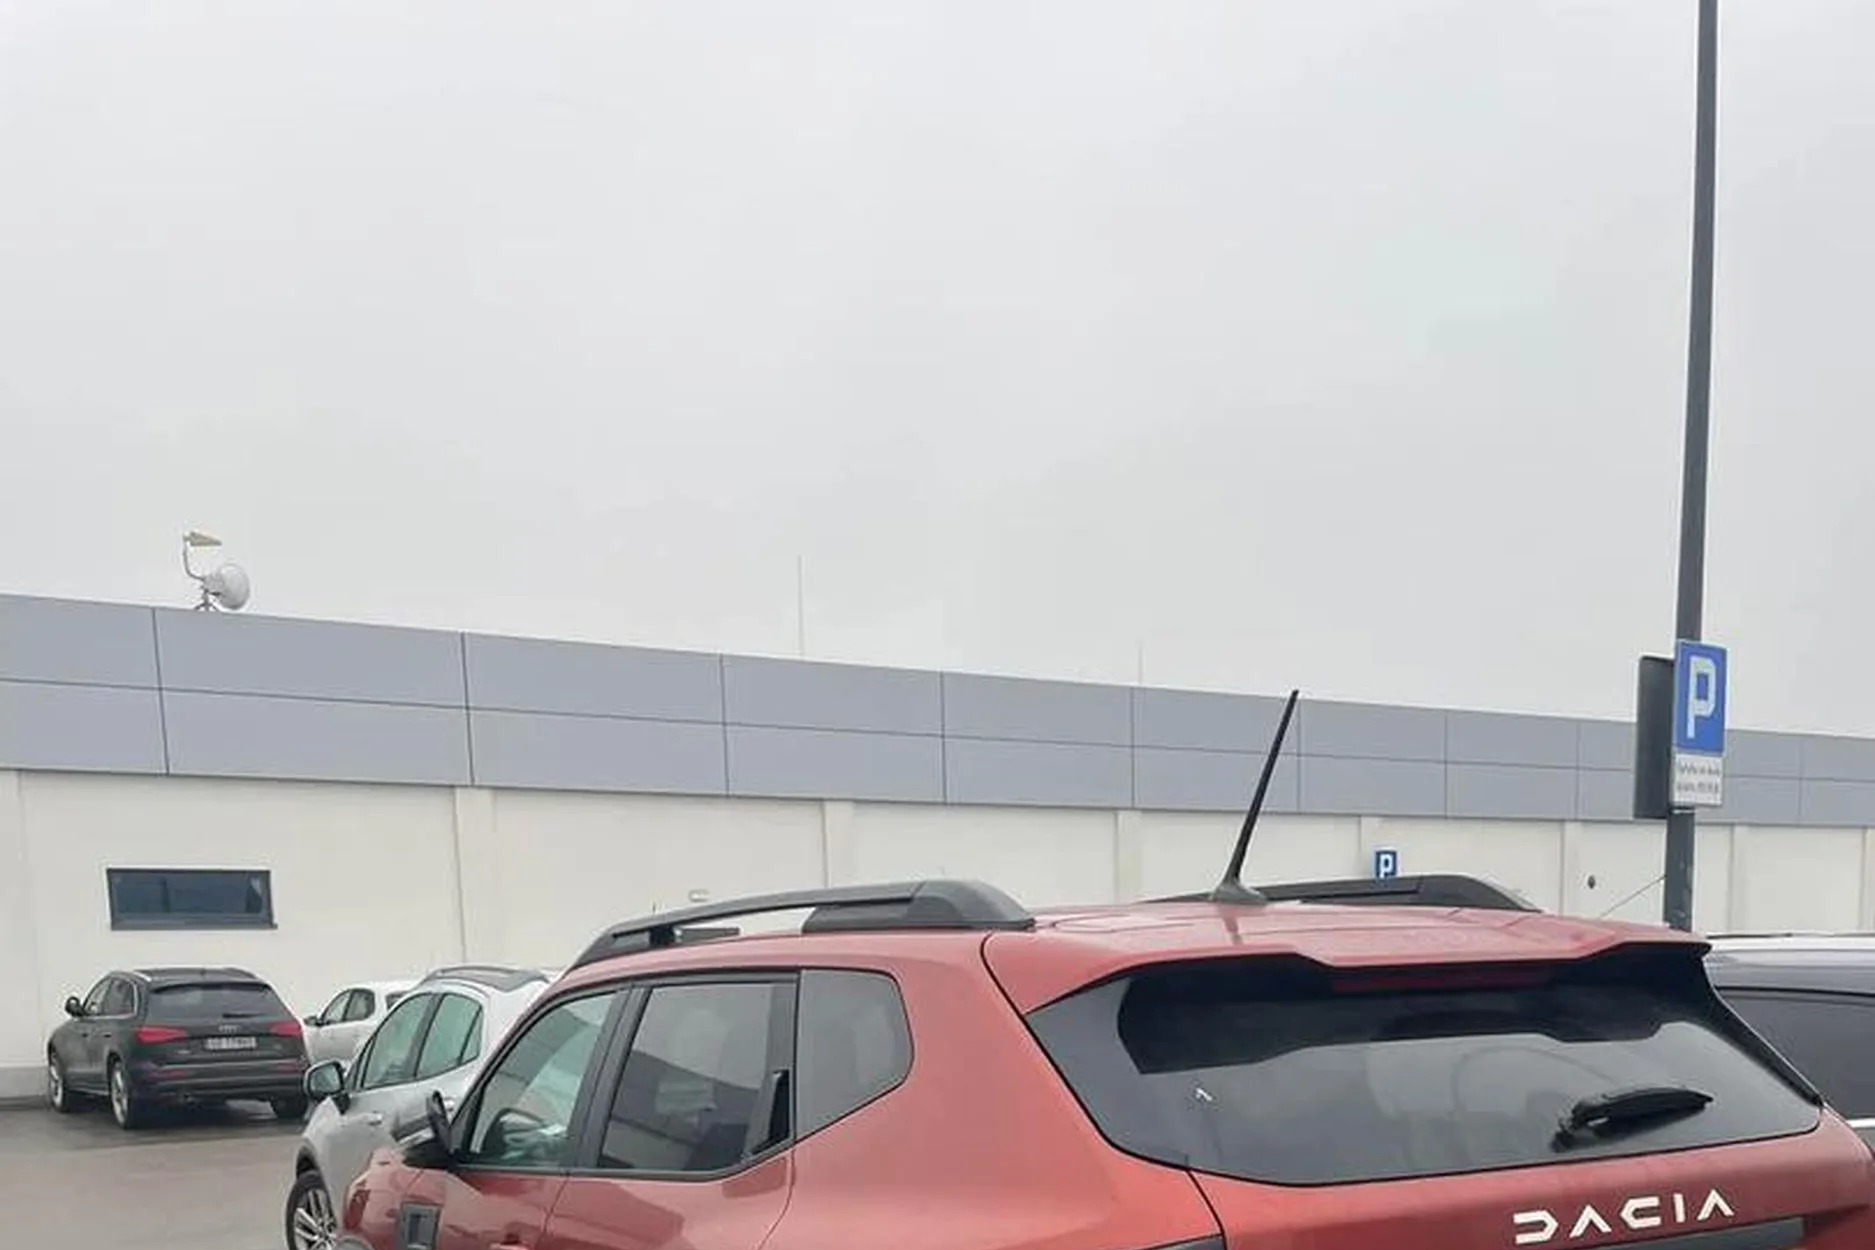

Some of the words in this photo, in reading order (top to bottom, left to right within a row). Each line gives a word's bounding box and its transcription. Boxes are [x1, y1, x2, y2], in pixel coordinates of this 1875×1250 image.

[1687, 655, 1717, 738] P
[1379, 853, 1393, 879] P
[1513, 1189, 1734, 1244] DACIA
